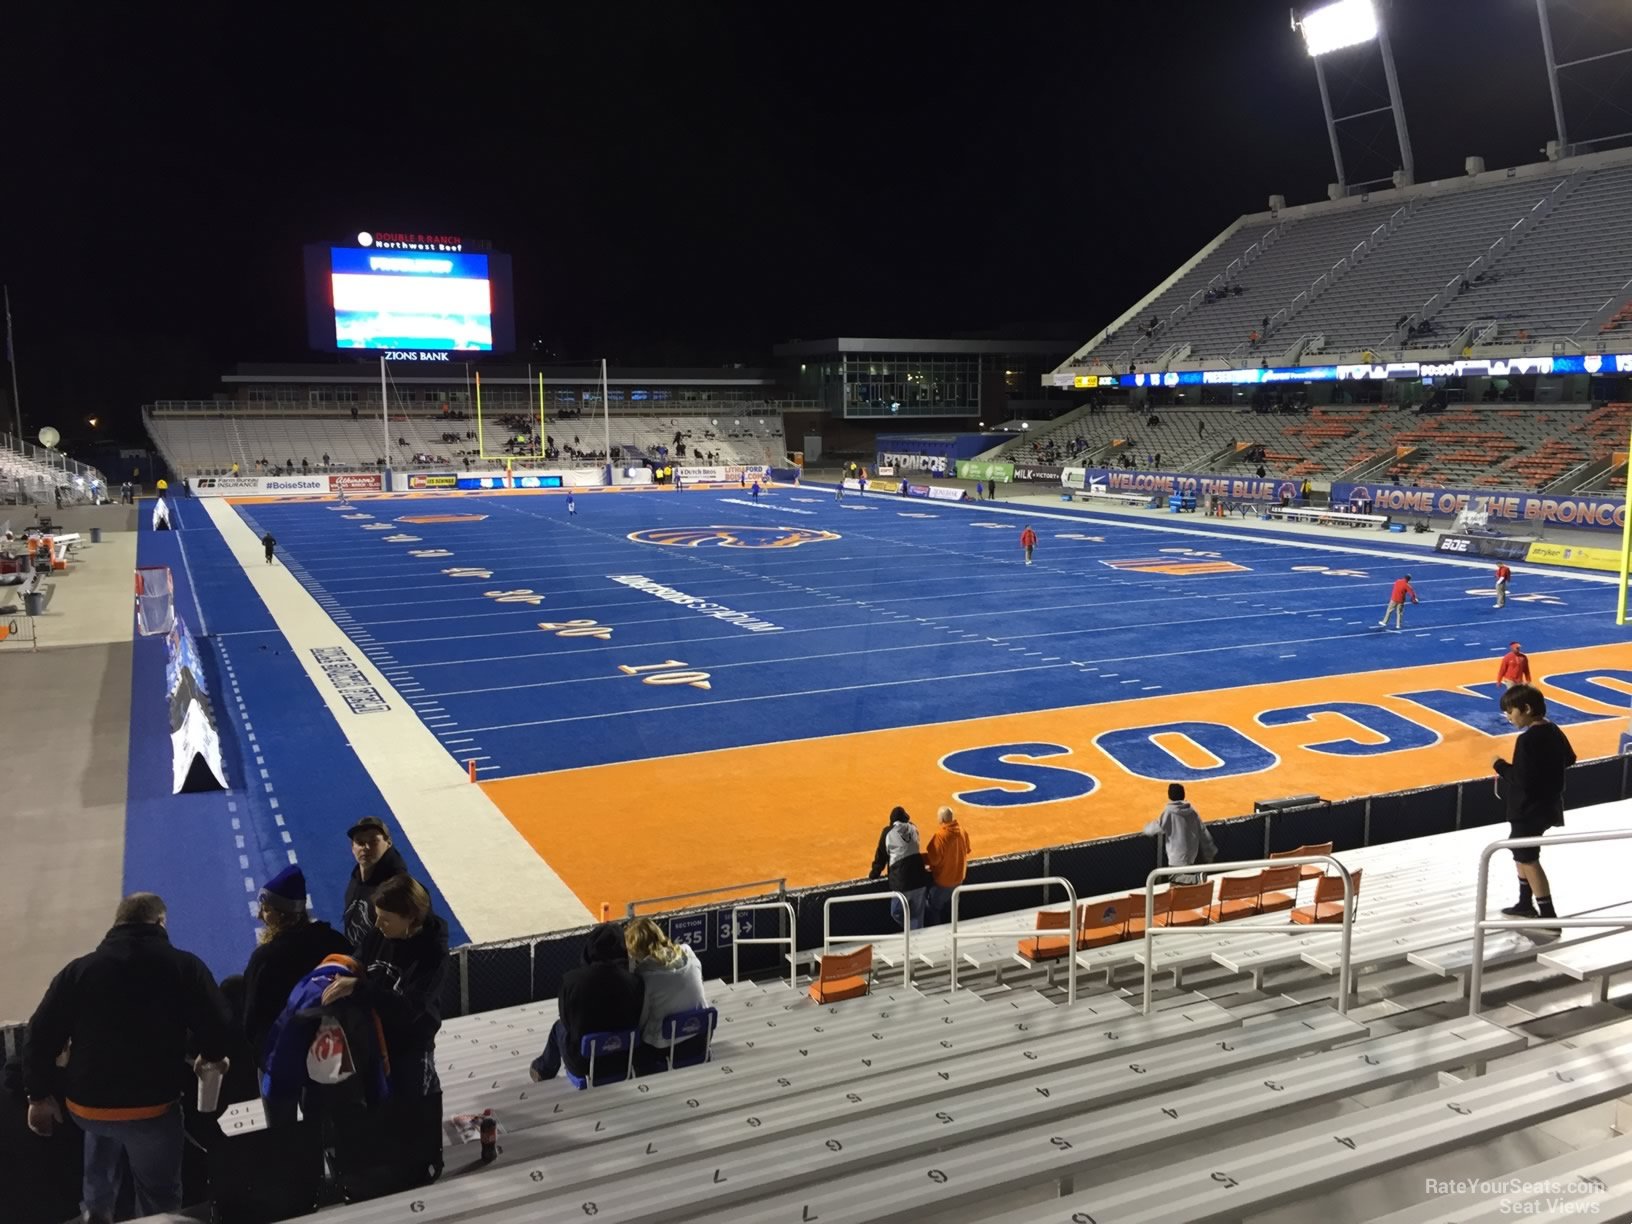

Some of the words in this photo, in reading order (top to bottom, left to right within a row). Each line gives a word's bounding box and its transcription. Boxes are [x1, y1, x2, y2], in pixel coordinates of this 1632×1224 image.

[376, 232, 415, 242] DOUBLE
[426, 235, 461, 244] RANCH
[376, 240, 435, 251] Northwest
[439, 244, 462, 252] Beef
[384, 352, 418, 360] ZIONS
[420, 352, 450, 361] BANK
[1014, 469, 1032, 480] MILK
[266, 482, 320, 490] #BoiseState
[1108, 472, 1174, 494] WELCOME
[1177, 476, 1197, 492] TO
[1200, 478, 1229, 497] THE
[1232, 480, 1275, 500] BLUE
[1375, 489, 1434, 512] HOME
[1438, 493, 1470, 513] OF
[617, 659, 712, 689] 10
[675, 920, 702, 929] SECTION
[683, 930, 702, 945] 35
[1104, 1032, 1120, 1040] 2
[1216, 1042, 1235, 1052] 2
[1023, 1050, 1038, 1060] 3
[1129, 1064, 1146, 1074] 3
[938, 1072, 950, 1080] 4
[1264, 1080, 1284, 1091] 3
[846, 1093, 862, 1104] 5
[1036, 1088, 1050, 1098] 4
[553, 1104, 564, 1114] 7
[1161, 1108, 1178, 1120] 4
[1446, 1102, 1472, 1116] 3
[936, 1112, 954, 1124] 5
[594, 1121, 606, 1132] 7
[646, 1142, 658, 1155] 7
[1050, 1136, 1072, 1150] 5
[1334, 1136, 1356, 1150] 4
[713, 1169, 728, 1184] 7
[1210, 1171, 1238, 1188] 5
[582, 1202, 598, 1216] 8
[802, 1205, 818, 1223] 7
